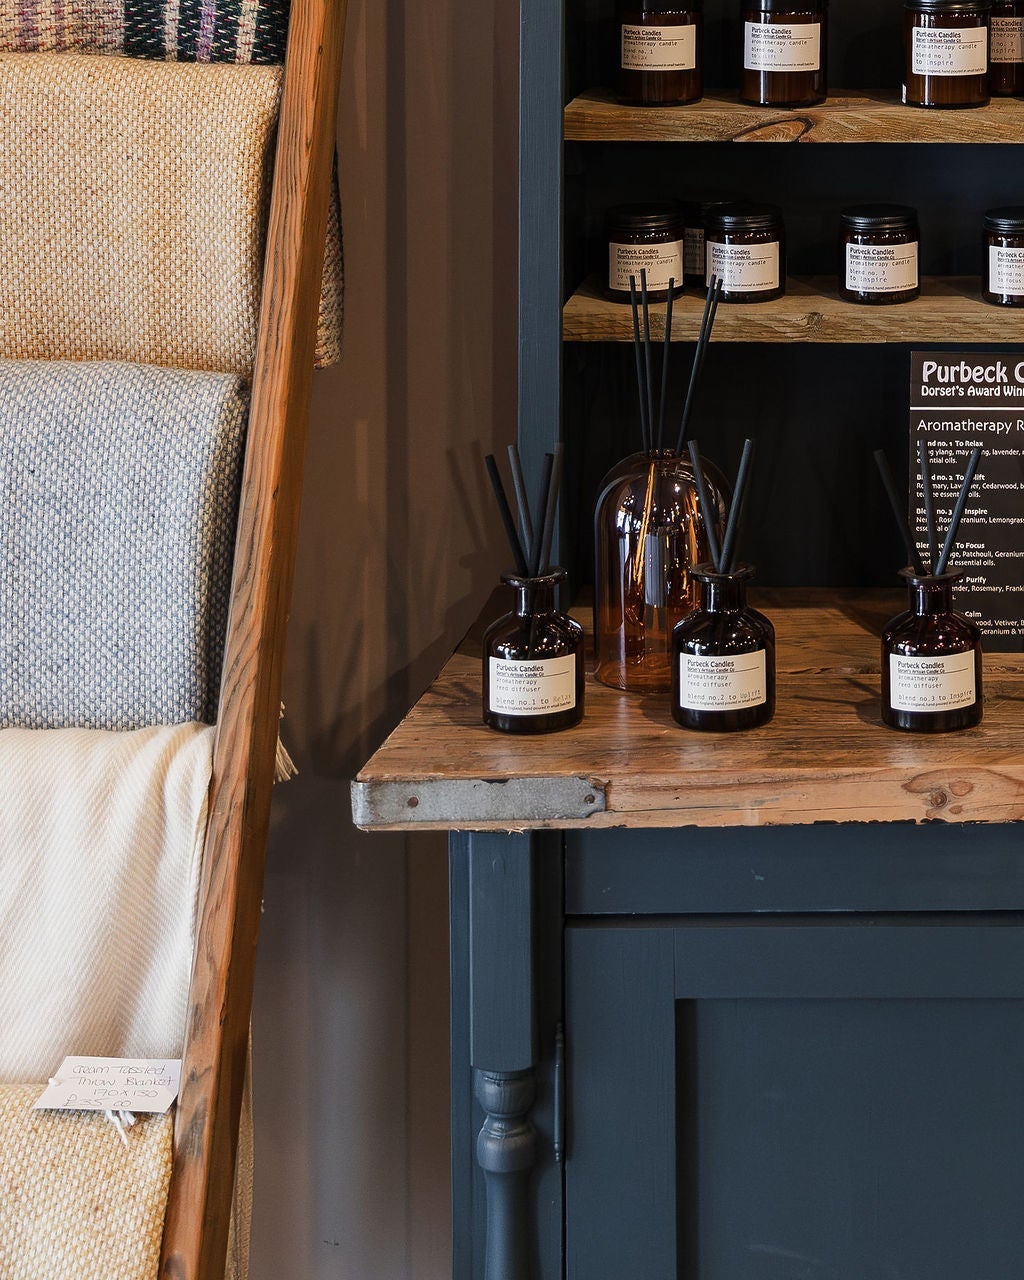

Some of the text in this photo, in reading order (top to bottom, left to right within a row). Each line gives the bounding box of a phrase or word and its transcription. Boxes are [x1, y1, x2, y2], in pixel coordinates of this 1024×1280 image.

[922, 361, 1008, 383] Purbeck
[921, 385, 965, 397] Dorset's
[967, 385, 1000, 397] Award
[917, 419, 1013, 434] Aromatherapy
[497, 664, 518, 672] Purbeck
[72, 1065, 110, 1074] Cream
